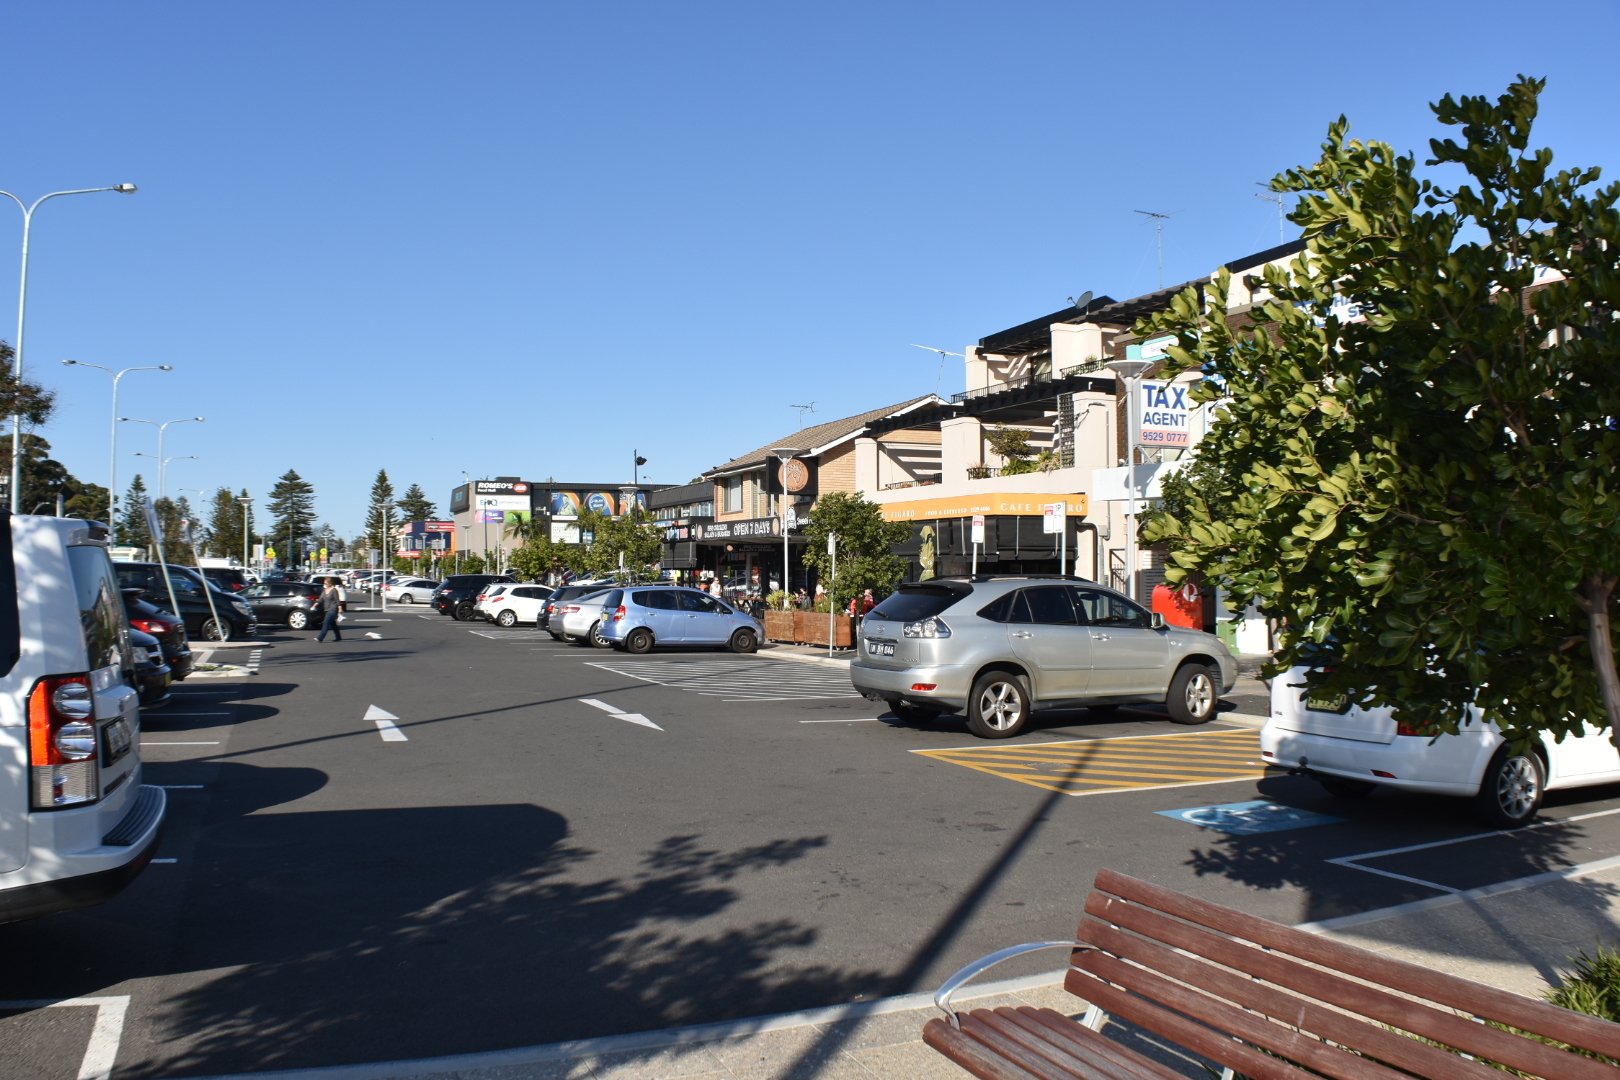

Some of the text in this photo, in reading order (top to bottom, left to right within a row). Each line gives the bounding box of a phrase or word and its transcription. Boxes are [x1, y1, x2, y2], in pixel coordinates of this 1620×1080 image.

[1142, 384, 1186, 410] TAX
[1142, 412, 1186, 426] AGENT
[1142, 431, 1187, 442] 9529 0777
[1000, 502, 1031, 512] CAFE
[1038, 503, 1083, 513] FRO
[891, 510, 916, 519] FIGARO
[733, 522, 749, 536] OPEN
[749, 522, 755, 535] 7
[754, 520, 770, 534] DAYS
